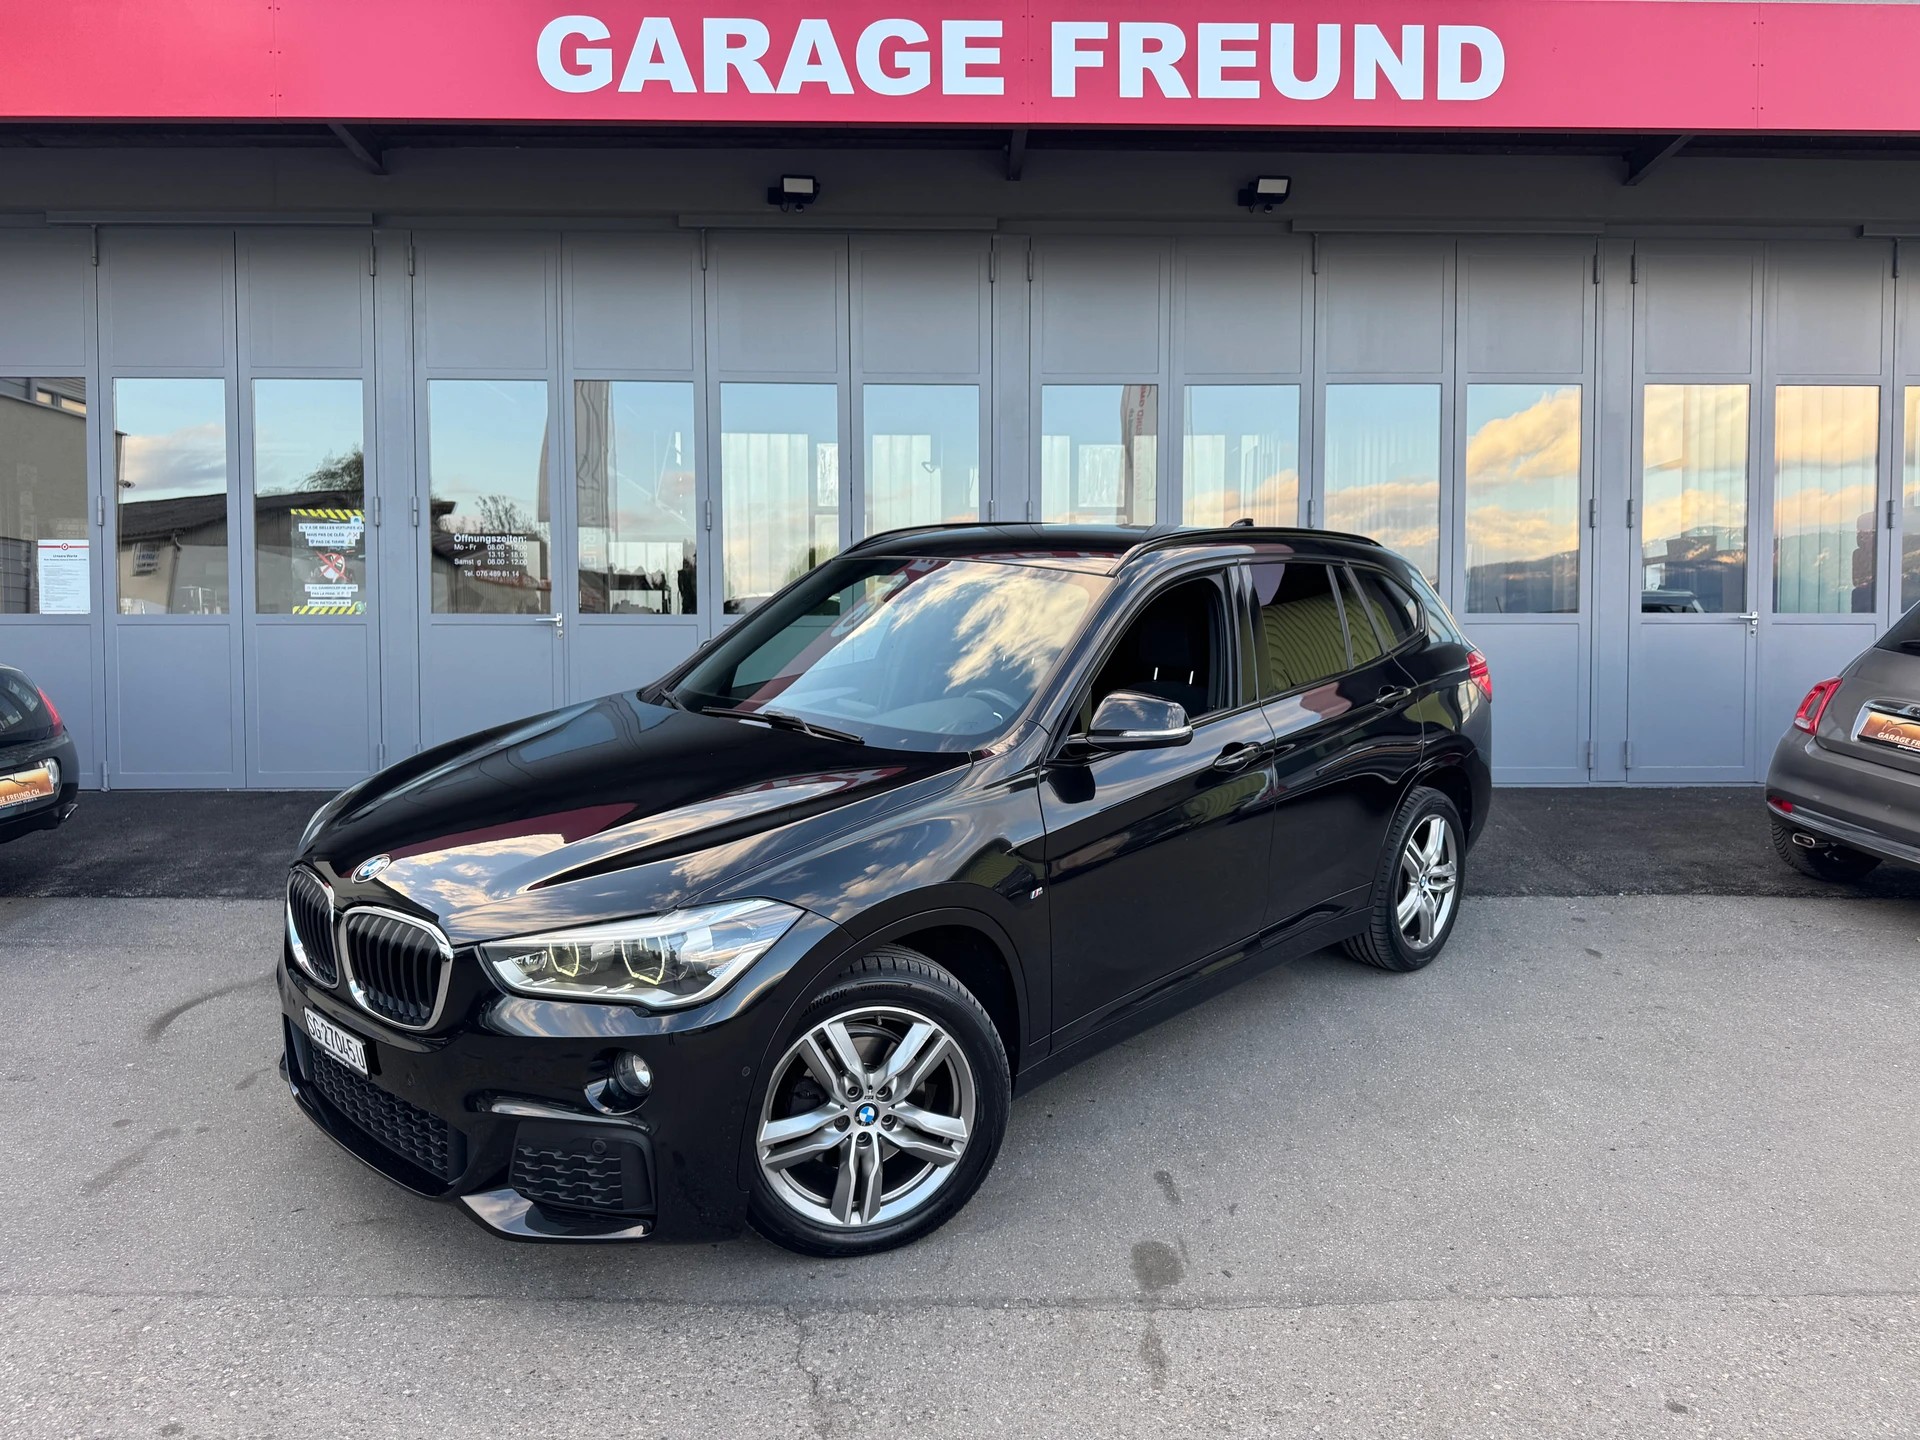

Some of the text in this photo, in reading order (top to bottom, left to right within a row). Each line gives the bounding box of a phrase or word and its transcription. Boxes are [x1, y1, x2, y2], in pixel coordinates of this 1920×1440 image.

[536, 15, 1505, 101] GARAGE FREUND
[454, 533, 527, 544] Öffnungszeiten:
[454, 558, 482, 566] Samstg
[1877, 732, 1910, 744] GARAGE
